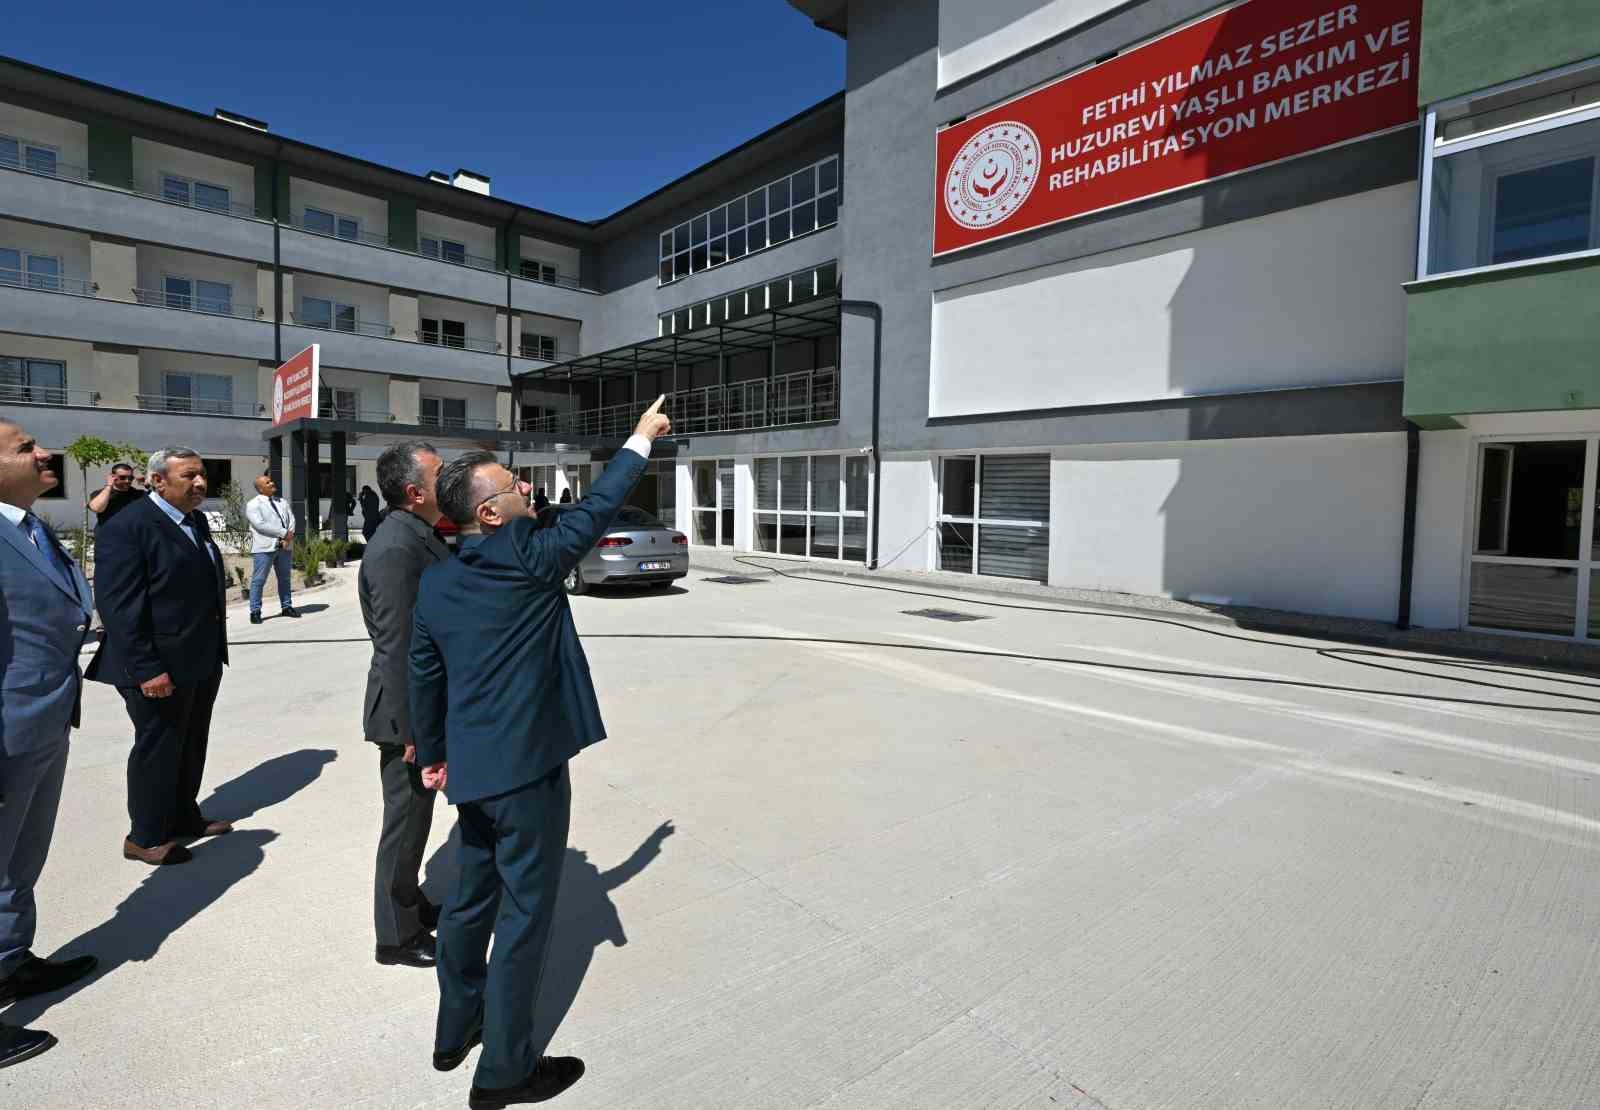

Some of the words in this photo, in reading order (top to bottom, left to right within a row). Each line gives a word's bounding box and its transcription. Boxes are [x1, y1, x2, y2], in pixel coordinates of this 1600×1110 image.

[1048, 108, 1256, 191] REHABİLİTASYON
[1263, 53, 1410, 124] MERKEZİ
[1050, 105, 1165, 163] HUZUREVİ
[1171, 80, 1244, 121] YAŞLI
[1252, 39, 1354, 94] BAKIM
[1364, 20, 1410, 53] VE
[1082, 81, 1145, 124] FETHİ
[1152, 44, 1252, 98] YILMAZ
[1260, 4, 1358, 57] SEZER
